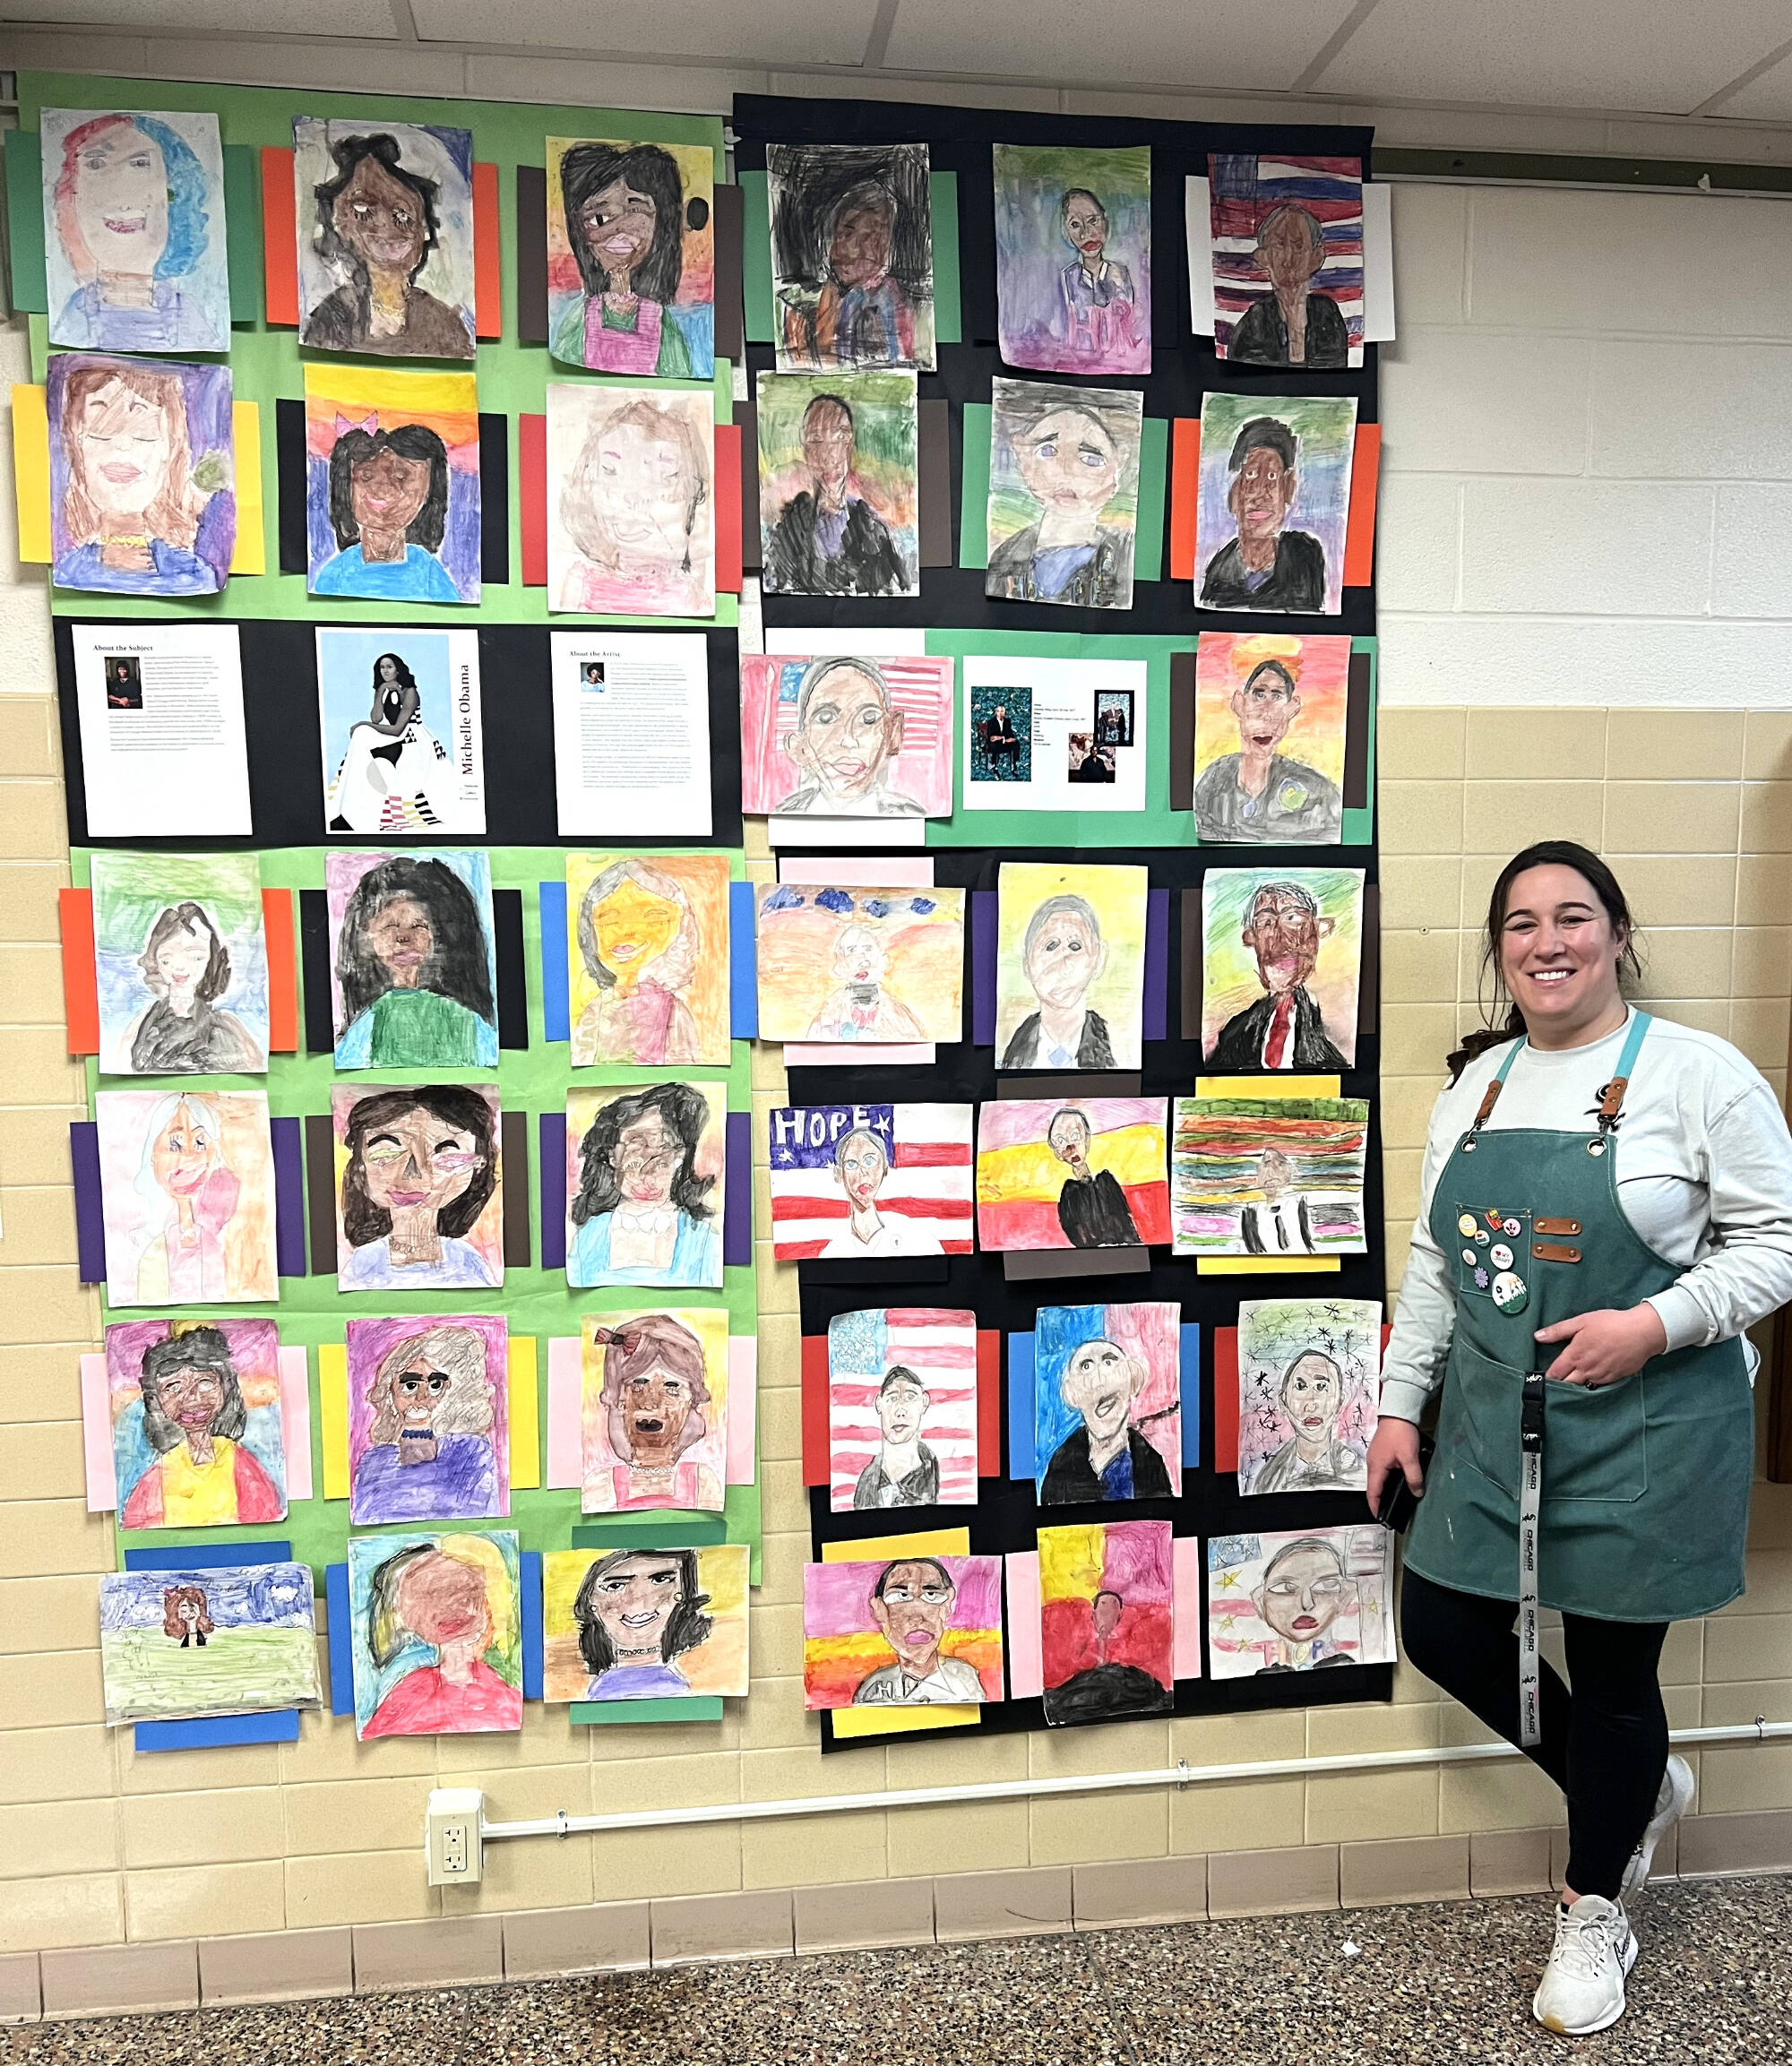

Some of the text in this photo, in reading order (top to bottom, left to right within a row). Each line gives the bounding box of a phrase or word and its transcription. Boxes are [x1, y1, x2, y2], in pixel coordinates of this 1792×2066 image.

[93, 644, 153, 653] About the Subject
[602, 650, 621, 658] Artist
[458, 664, 471, 714] Obama
[459, 717, 474, 776] Michelle
[774, 1106, 872, 1148] HOPE
[1528, 1692, 1536, 1735] CHICAGO
